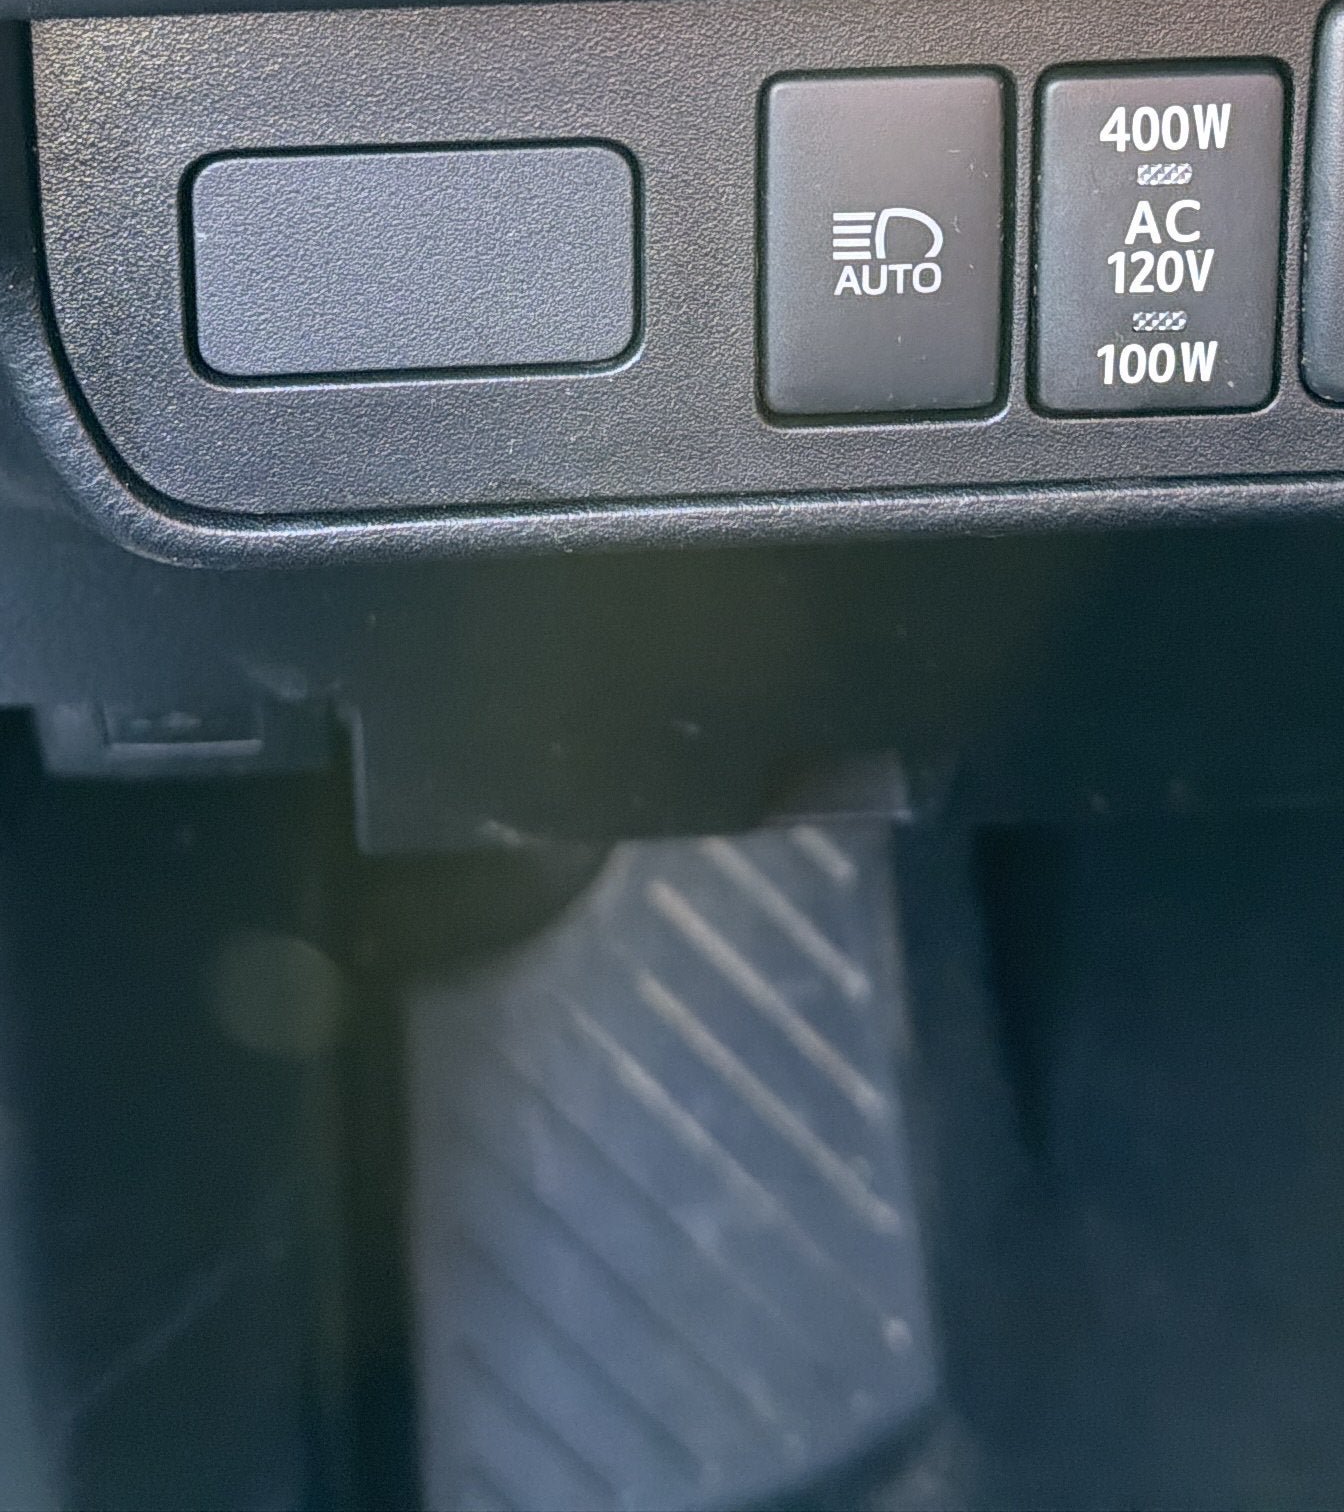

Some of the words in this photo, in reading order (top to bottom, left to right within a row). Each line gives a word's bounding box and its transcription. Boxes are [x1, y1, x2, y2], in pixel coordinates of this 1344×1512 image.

[1099, 102, 1232, 153] 400W
[1124, 199, 1202, 245] AC
[833, 262, 943, 297] AUTO
[1107, 248, 1215, 294] 120V
[1096, 340, 1218, 386] 100W
